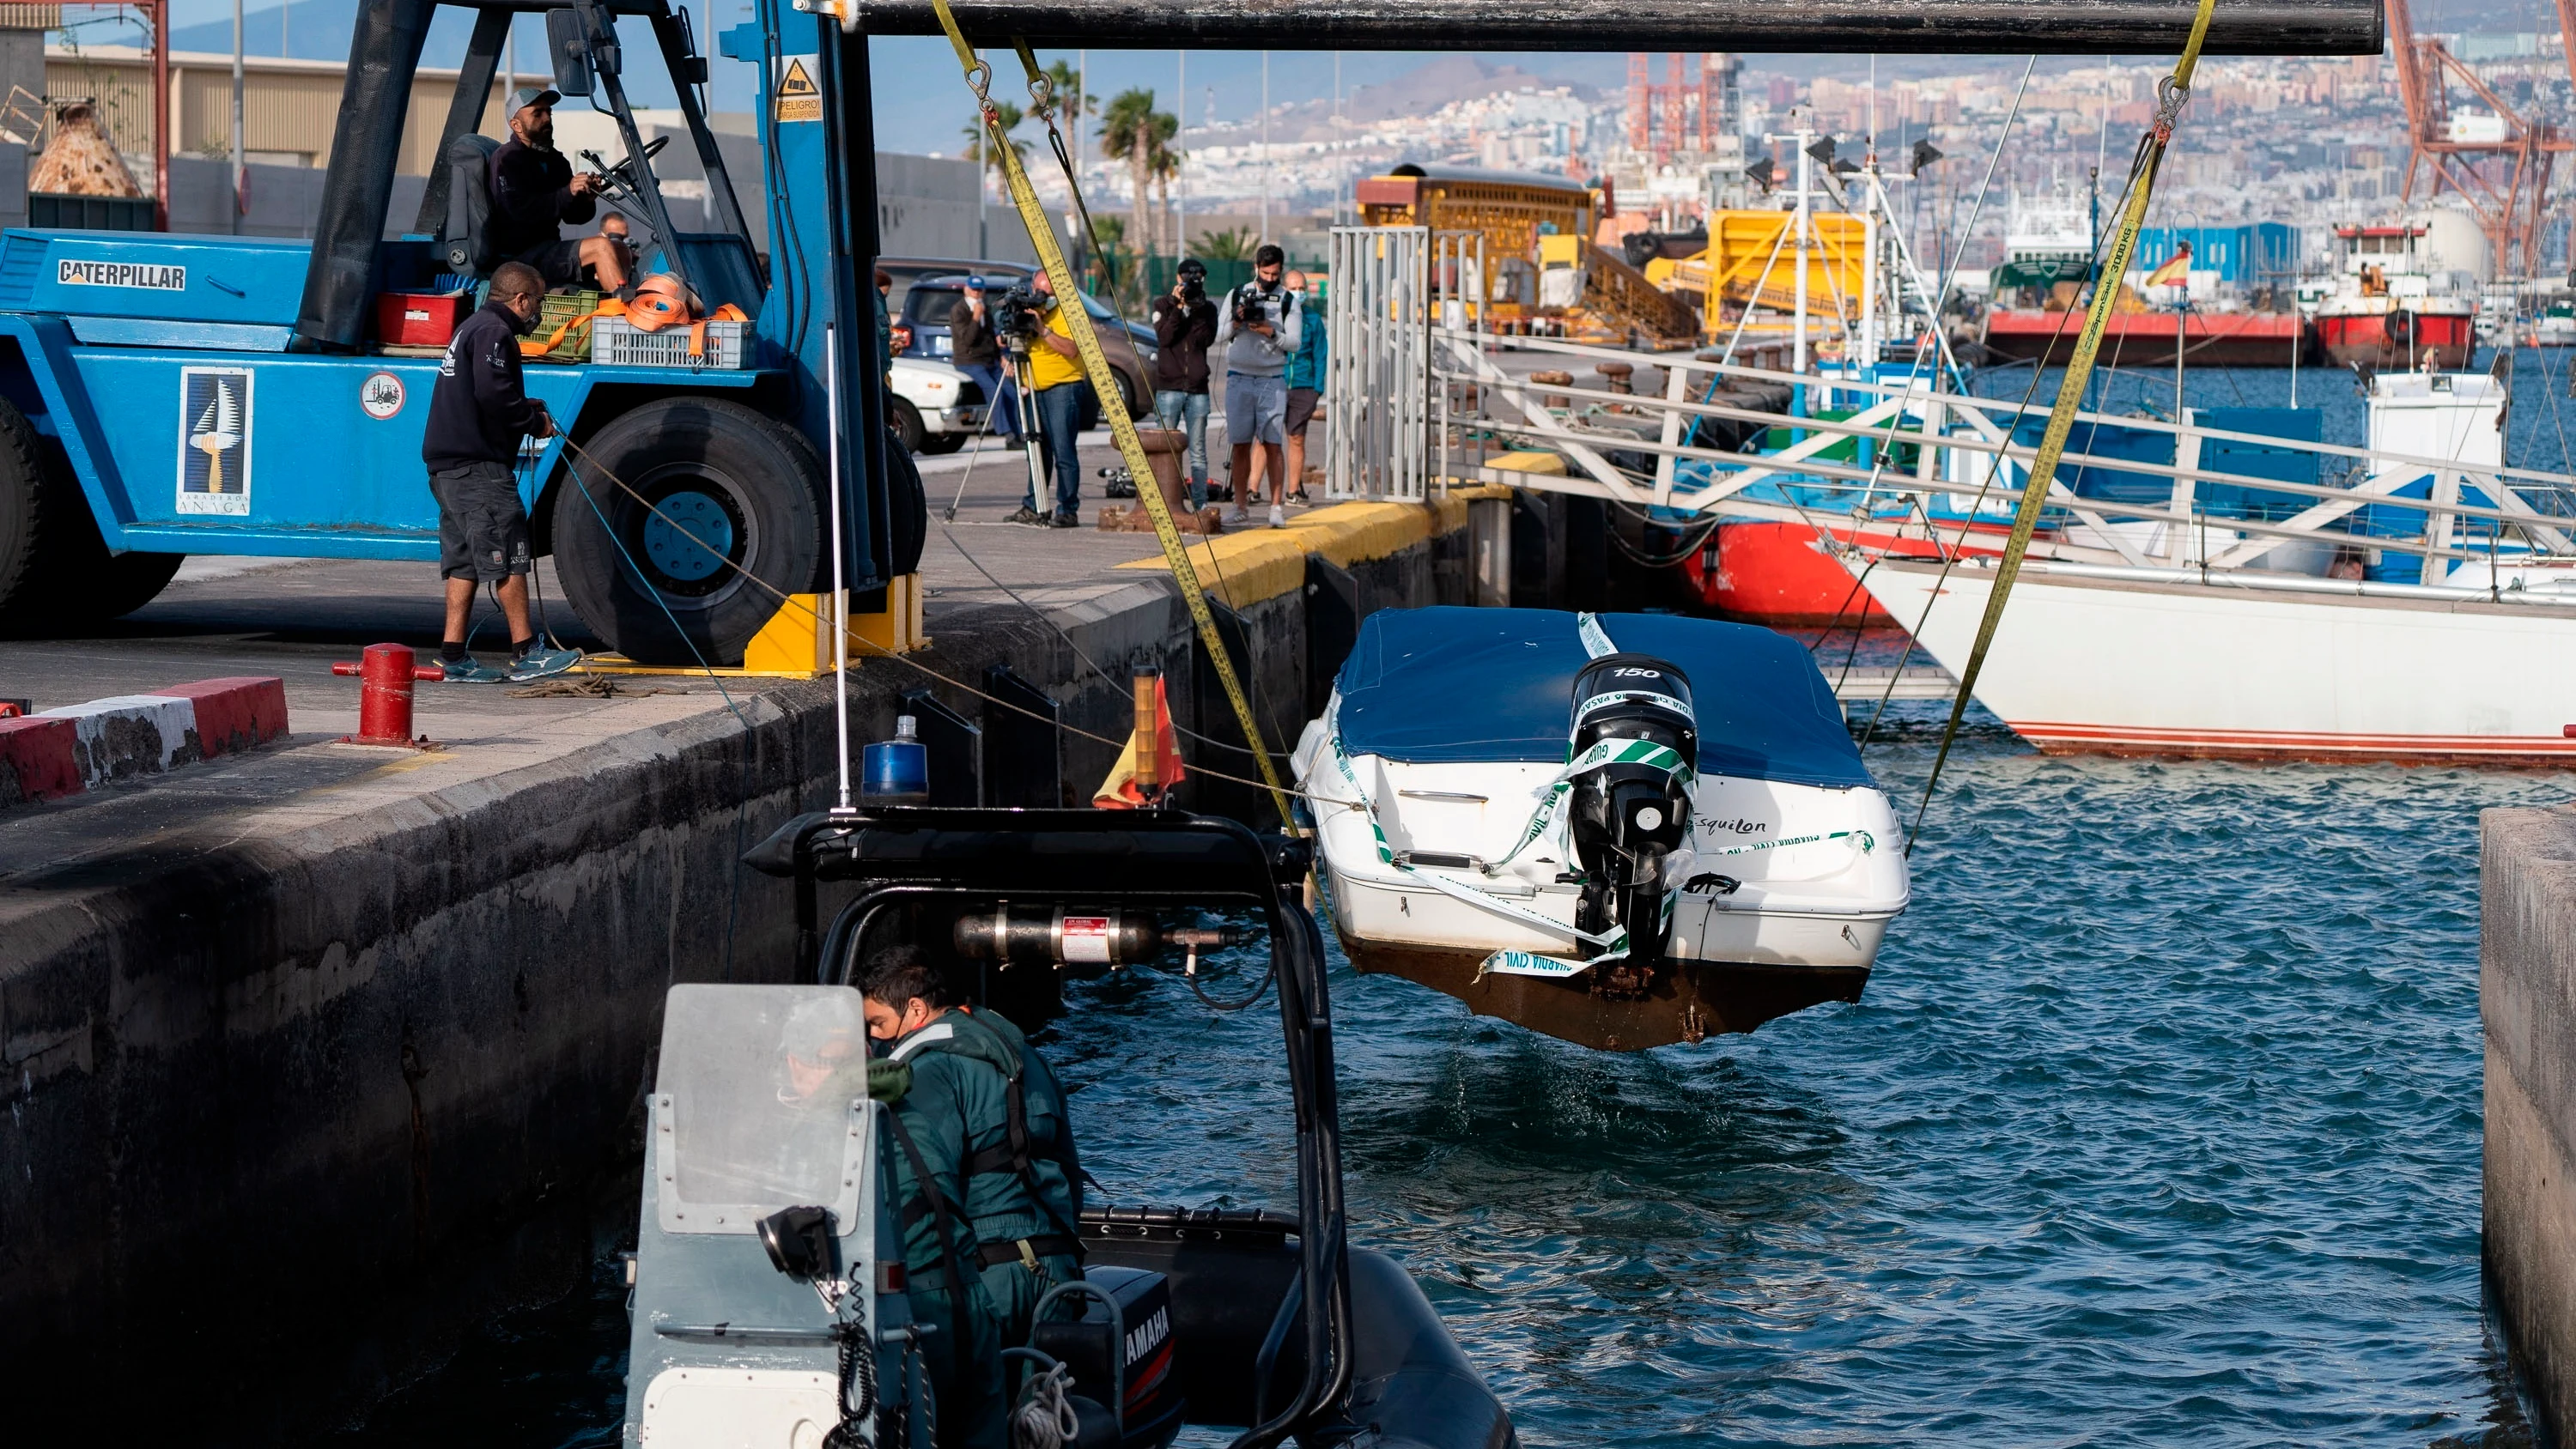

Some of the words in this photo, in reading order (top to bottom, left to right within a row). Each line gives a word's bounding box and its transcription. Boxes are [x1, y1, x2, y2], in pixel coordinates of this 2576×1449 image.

[2111, 243, 2127, 273] 3000
[2121, 227, 2132, 243] KG
[60, 261, 184, 288] CATERPILLAR
[1614, 668, 1661, 678] 150
[1581, 696, 1610, 715] PASAR
[1528, 818, 1546, 842] CIVIL
[1504, 951, 1528, 968] CIVIL
[1122, 1305, 1170, 1368] AMAHA
